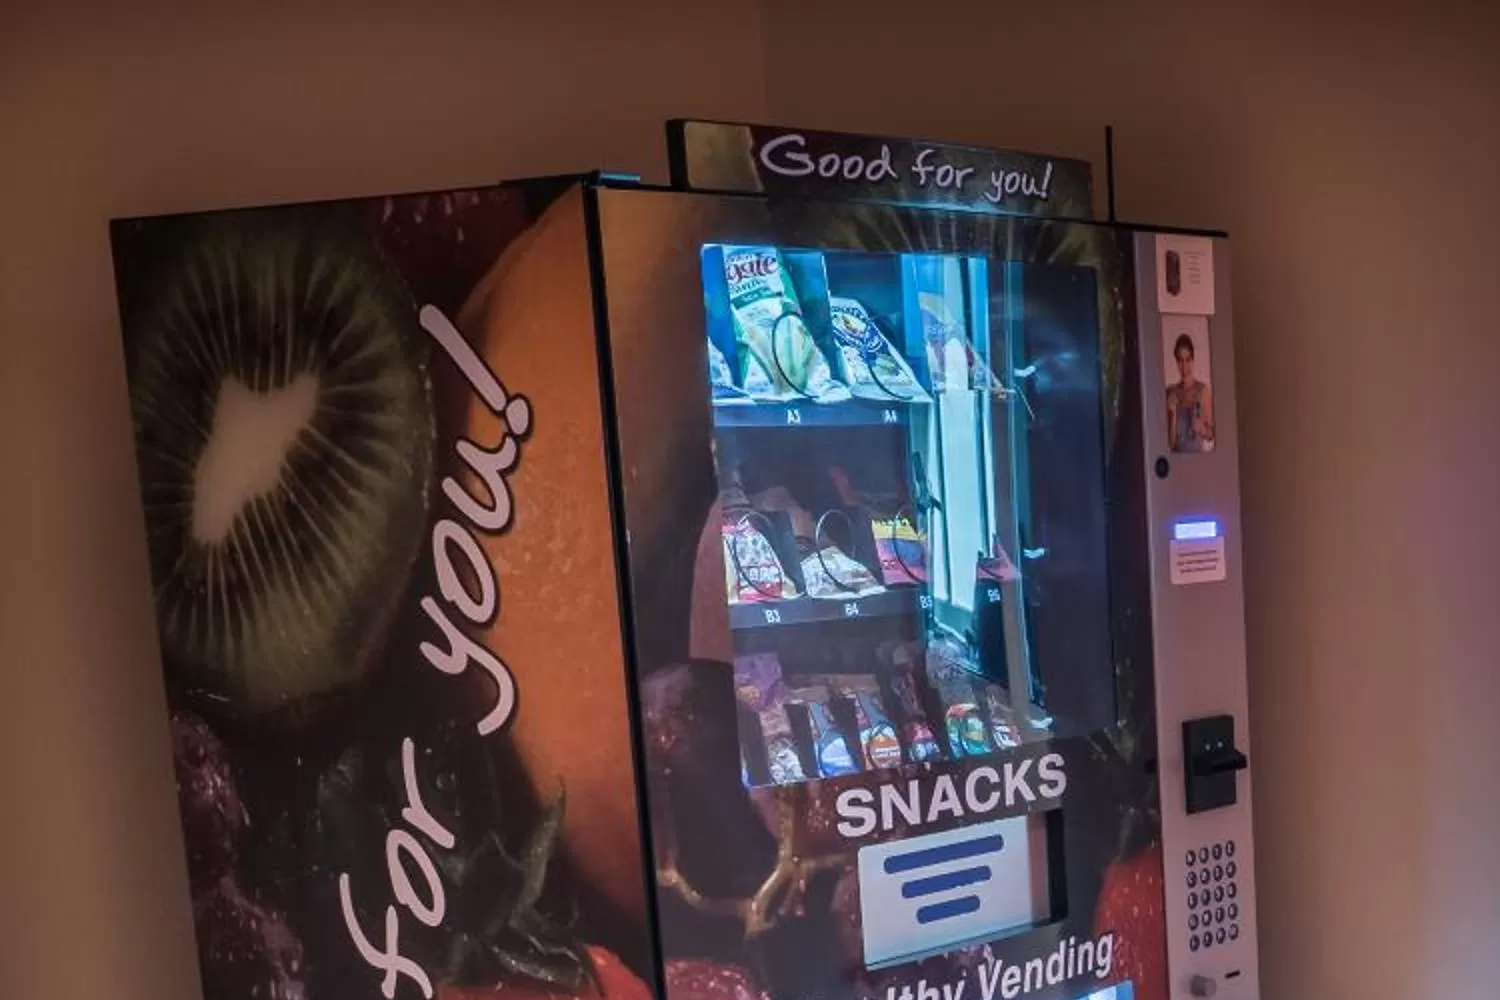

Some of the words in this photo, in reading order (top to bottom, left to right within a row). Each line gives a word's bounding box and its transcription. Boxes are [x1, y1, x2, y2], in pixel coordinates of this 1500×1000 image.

[759, 133, 897, 181] Good
[912, 149, 973, 188] for
[984, 162, 1053, 202] you!
[339, 736, 455, 1000] for
[419, 303, 531, 736] you!
[835, 753, 1068, 838] SNACKS
